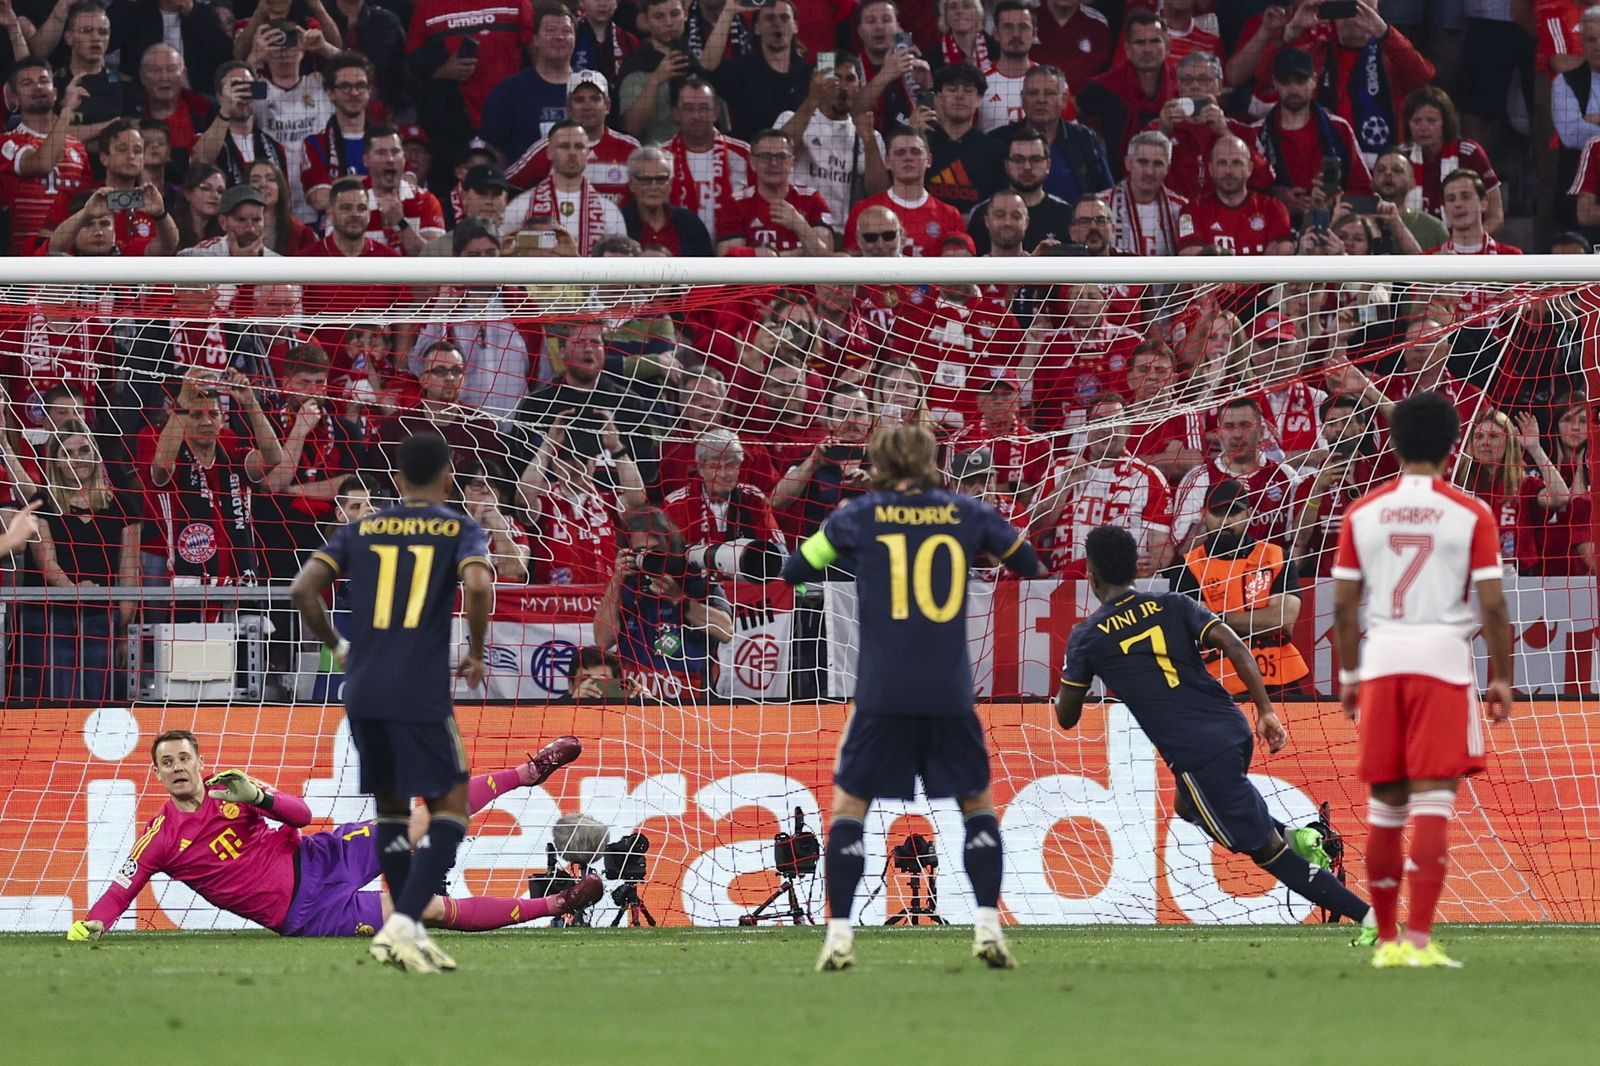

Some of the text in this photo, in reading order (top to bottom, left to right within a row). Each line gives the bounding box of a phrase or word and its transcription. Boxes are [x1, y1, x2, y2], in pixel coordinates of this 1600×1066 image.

[448, 14, 496, 28] umbro
[828, 155, 847, 171] Fly
[927, 184, 981, 202] adidas
[230, 473, 246, 530] MADRID
[875, 502, 960, 525] MODRIĆ
[1380, 506, 1445, 526] GNABRY
[359, 516, 460, 538] RODRYGO
[369, 544, 435, 630] 11
[876, 533, 966, 624] 10
[1388, 533, 1434, 620] 7
[520, 596, 603, 613] MYTHOS
[1097, 609, 1138, 635] VINI
[1138, 600, 1164, 619] JR
[1119, 624, 1181, 689] 7
[342, 825, 371, 842] 1
